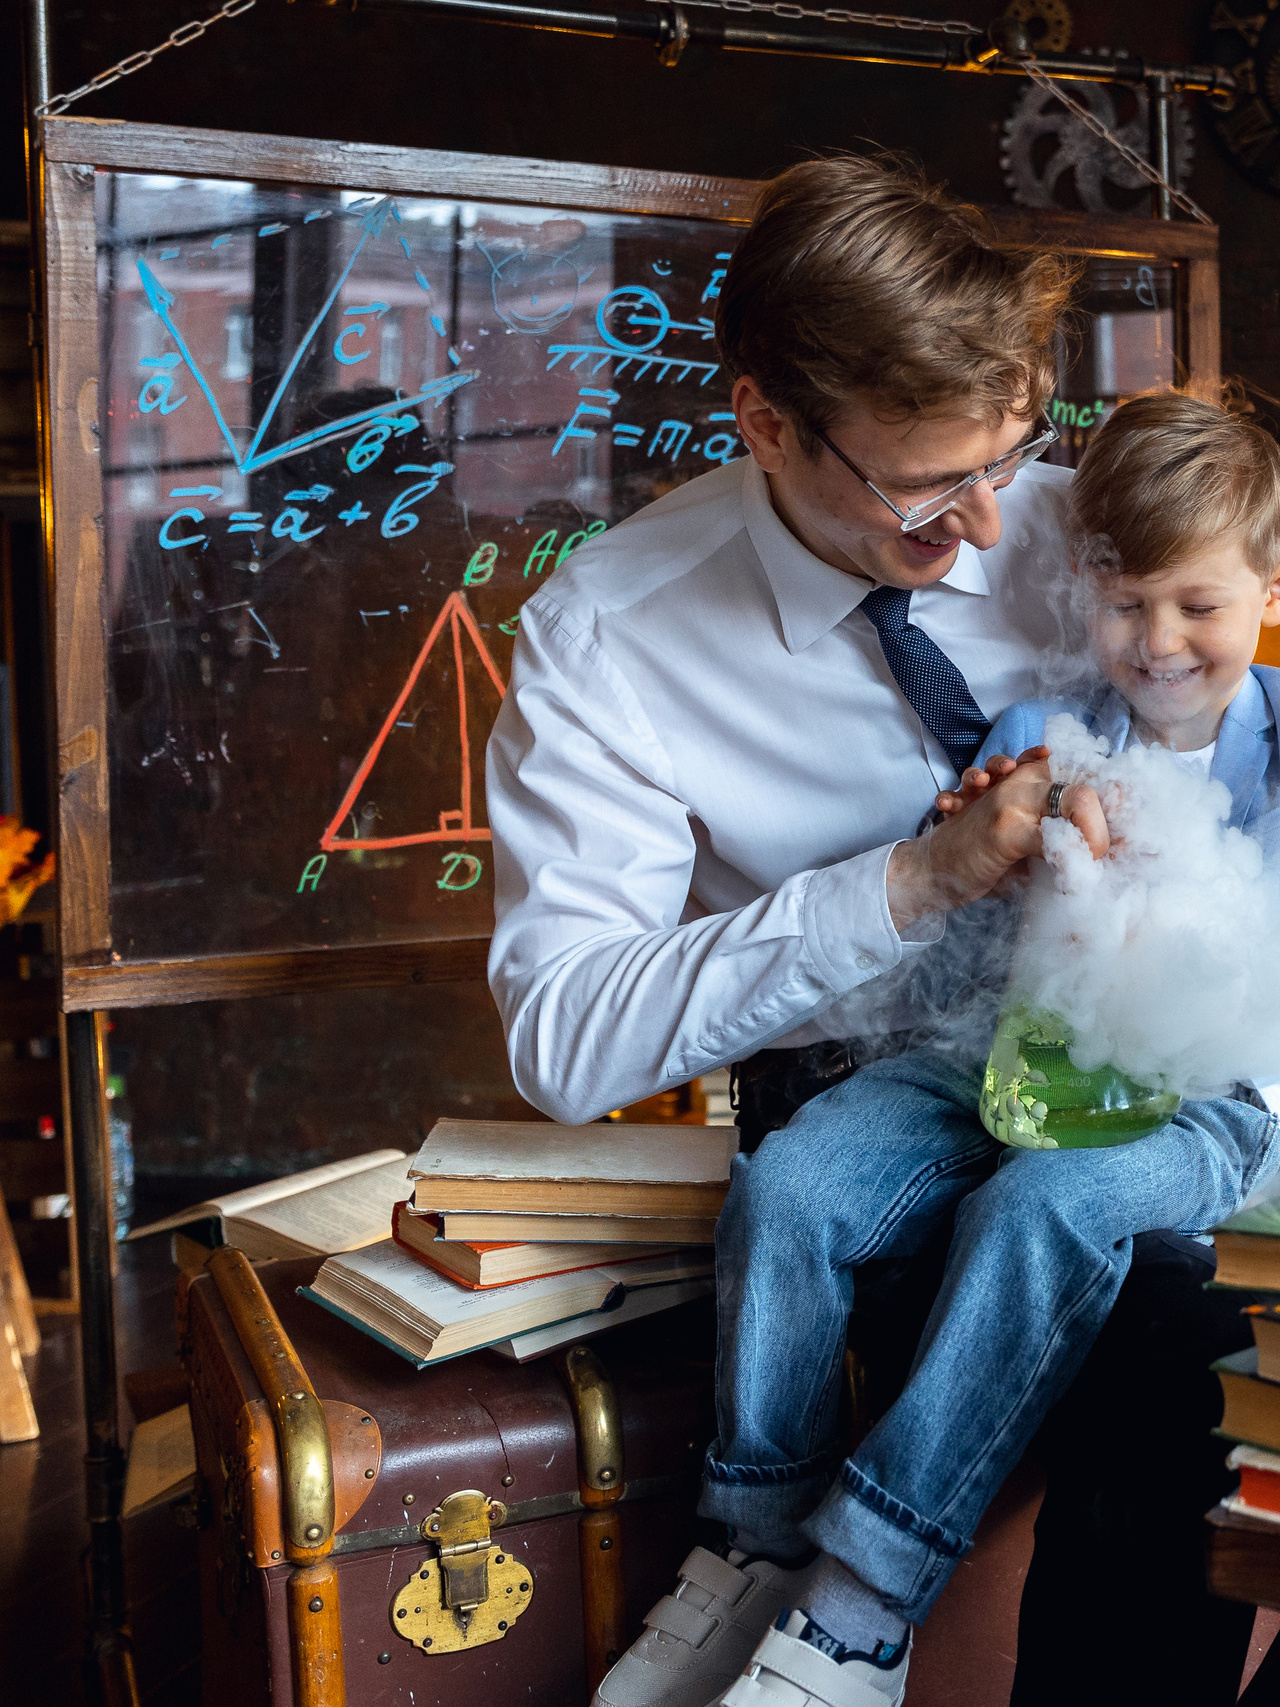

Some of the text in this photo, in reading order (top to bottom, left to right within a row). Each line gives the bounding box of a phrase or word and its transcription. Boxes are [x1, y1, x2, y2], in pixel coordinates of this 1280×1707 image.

[463, 541, 500, 587] B
[296, 854, 328, 894] A
[436, 852, 483, 891] D
[1067, 1076, 1092, 1089] 400
